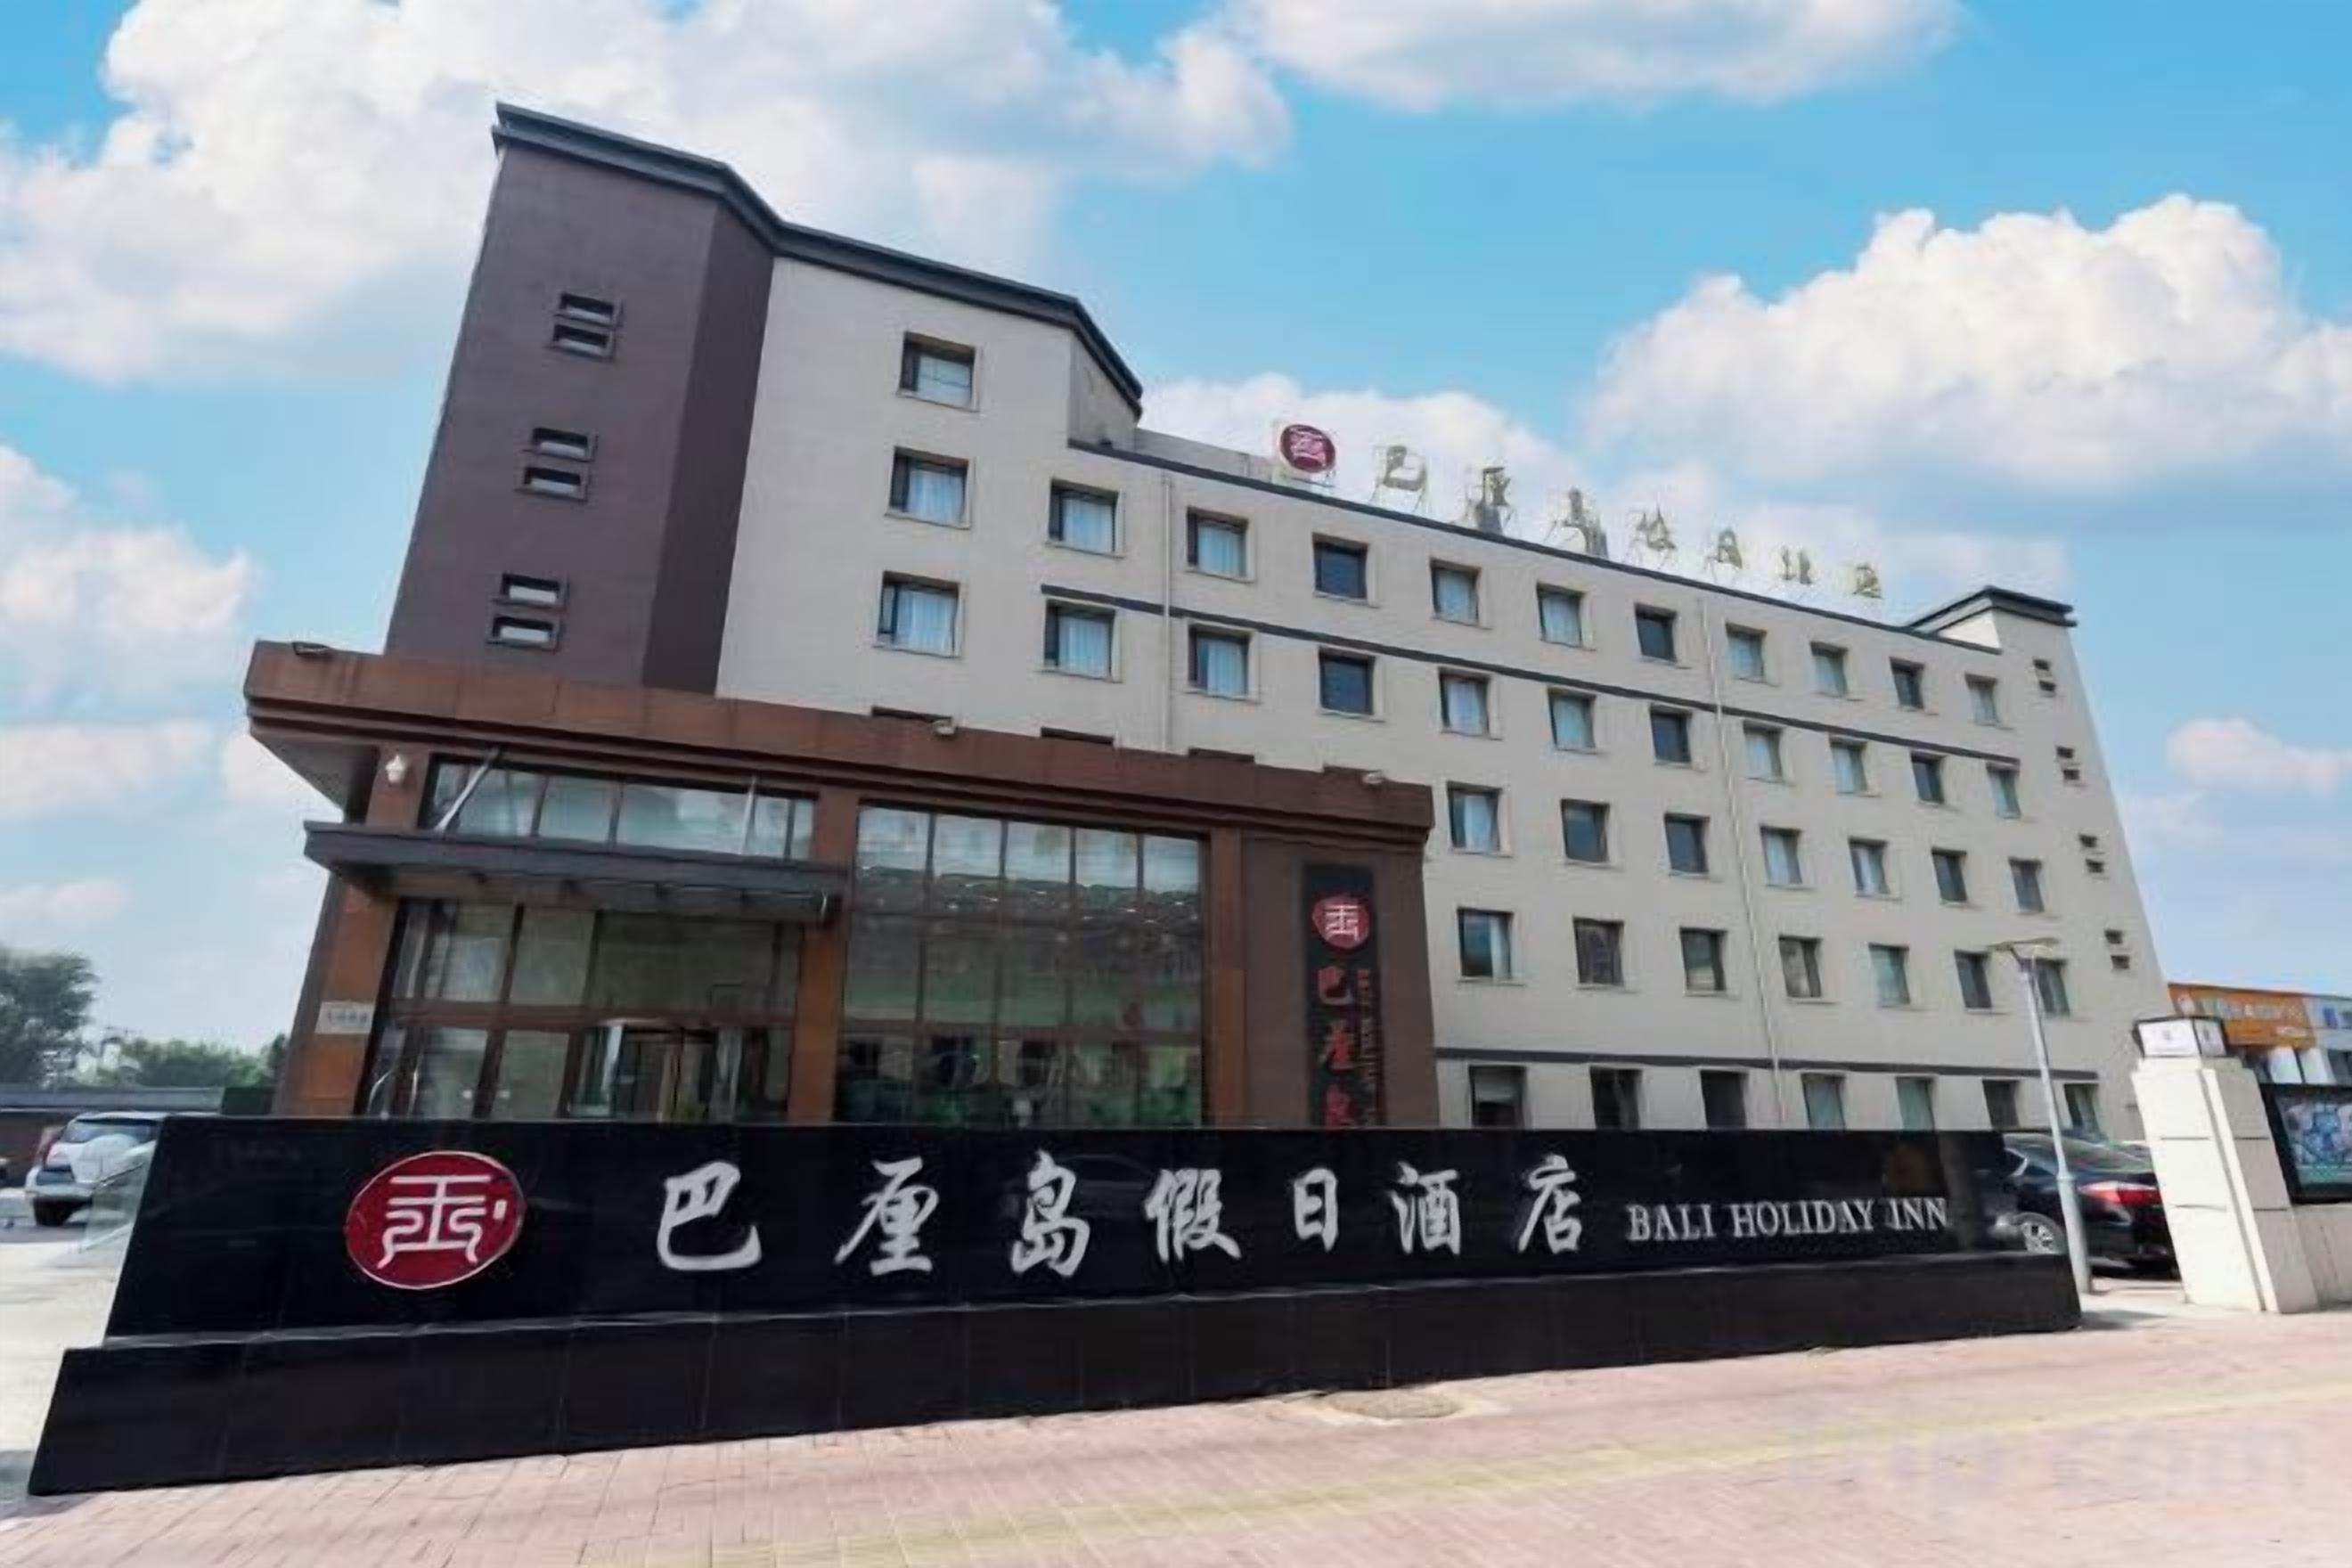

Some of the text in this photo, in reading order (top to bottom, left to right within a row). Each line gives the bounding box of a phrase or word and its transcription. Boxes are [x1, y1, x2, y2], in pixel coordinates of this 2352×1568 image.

[656, 1151, 1583, 1276] 巴厘岛假日酒店
[1626, 1196, 1948, 1241] BALI HOLIDAY INN
